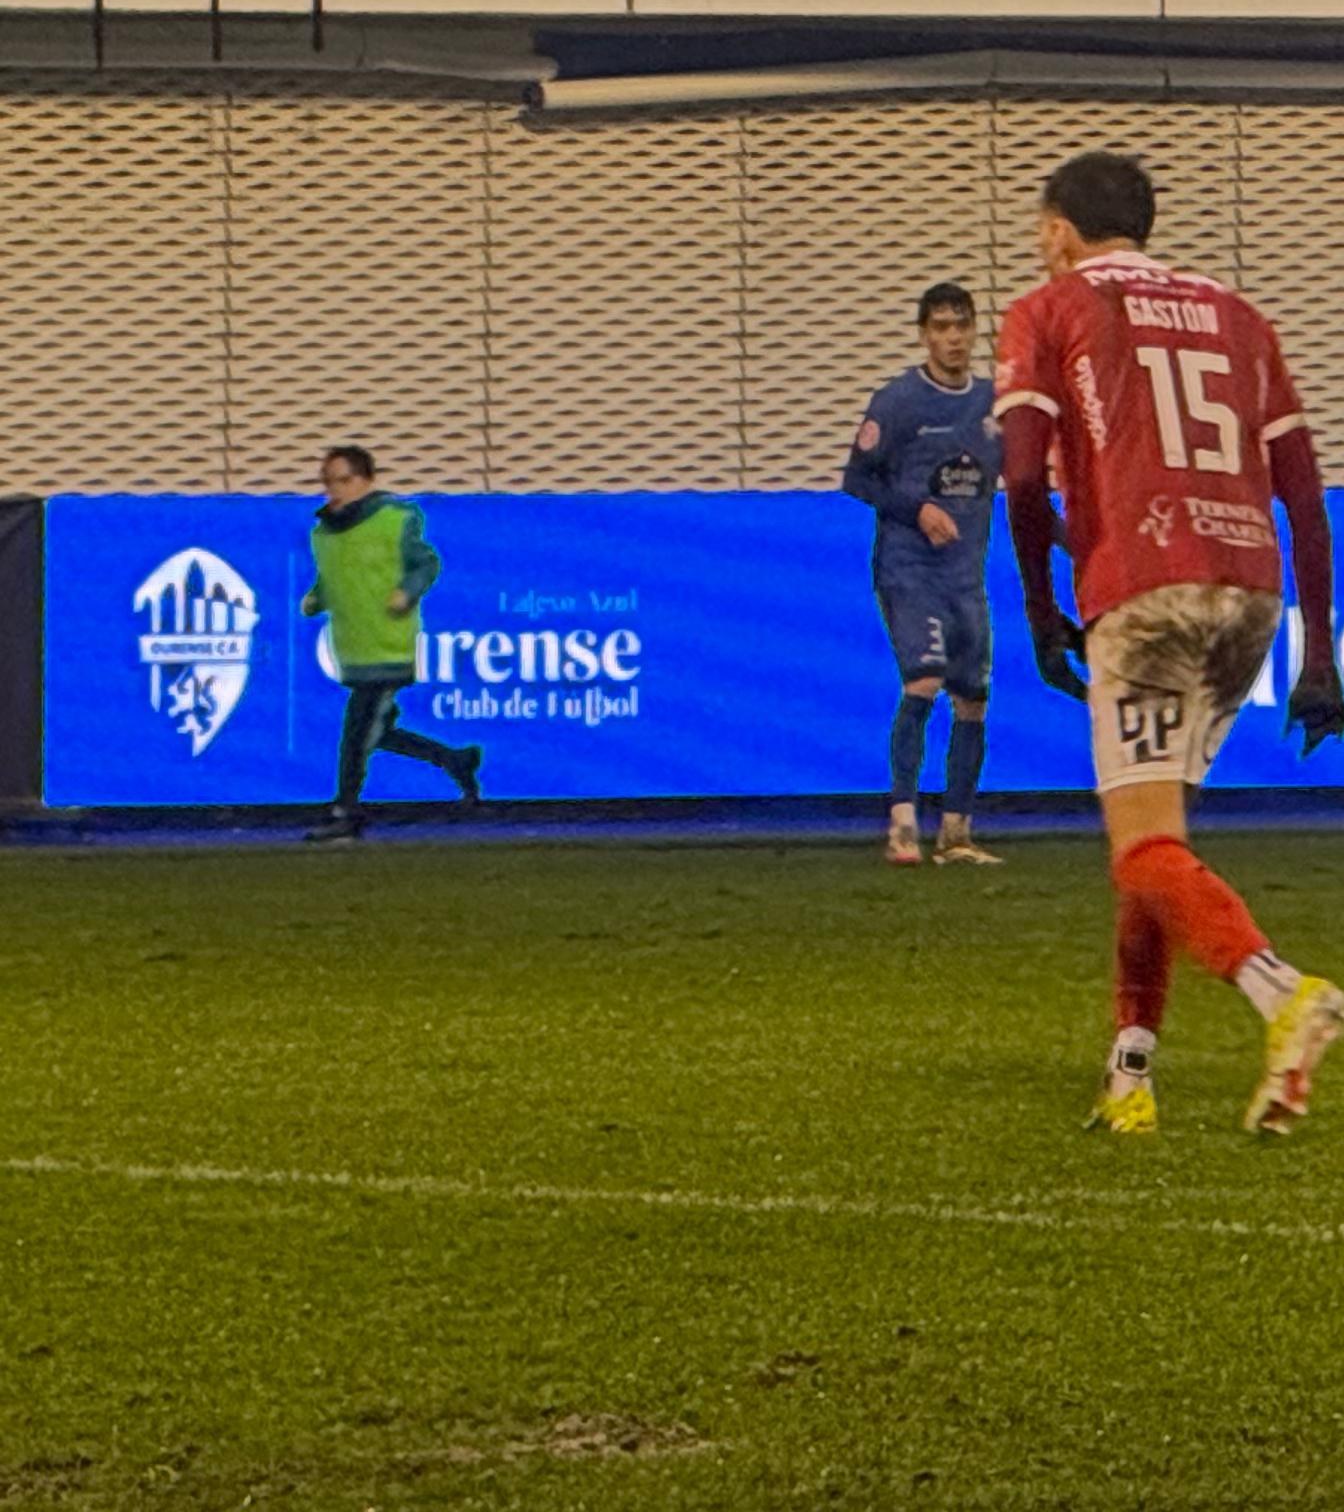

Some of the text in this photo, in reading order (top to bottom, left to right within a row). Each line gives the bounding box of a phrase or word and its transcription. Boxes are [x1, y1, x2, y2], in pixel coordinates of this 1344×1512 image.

[1136, 346, 1241, 475] 15
[432, 687, 499, 720] Club
[503, 687, 538, 720] de
